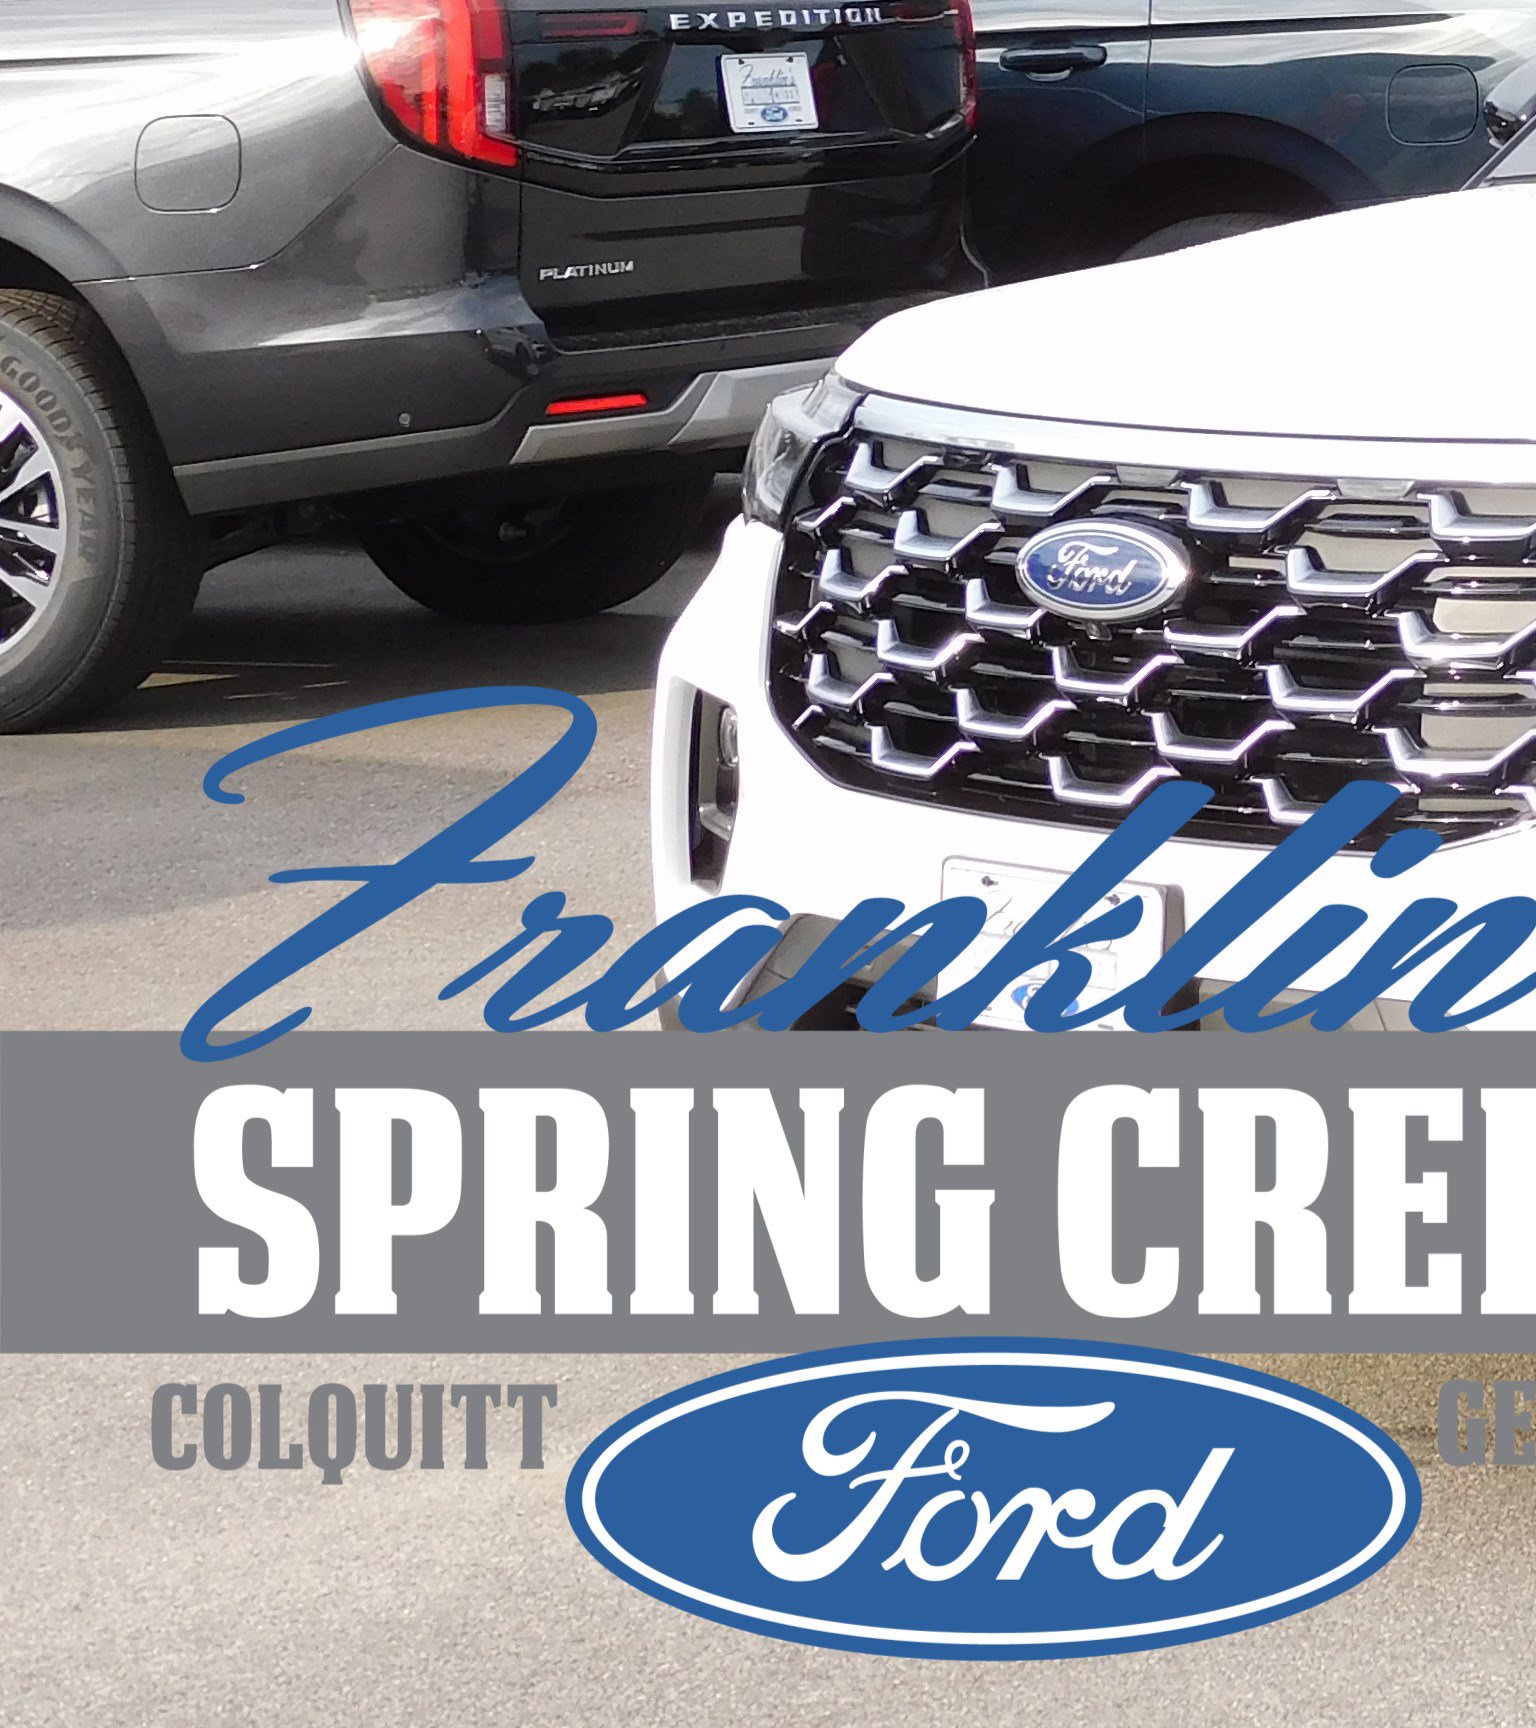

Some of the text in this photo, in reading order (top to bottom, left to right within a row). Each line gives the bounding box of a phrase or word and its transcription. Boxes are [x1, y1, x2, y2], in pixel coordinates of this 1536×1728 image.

[670, 7, 883, 31] EXPEDITION
[539, 260, 634, 281] PLATINUM
[1047, 540, 1138, 596] Ford
